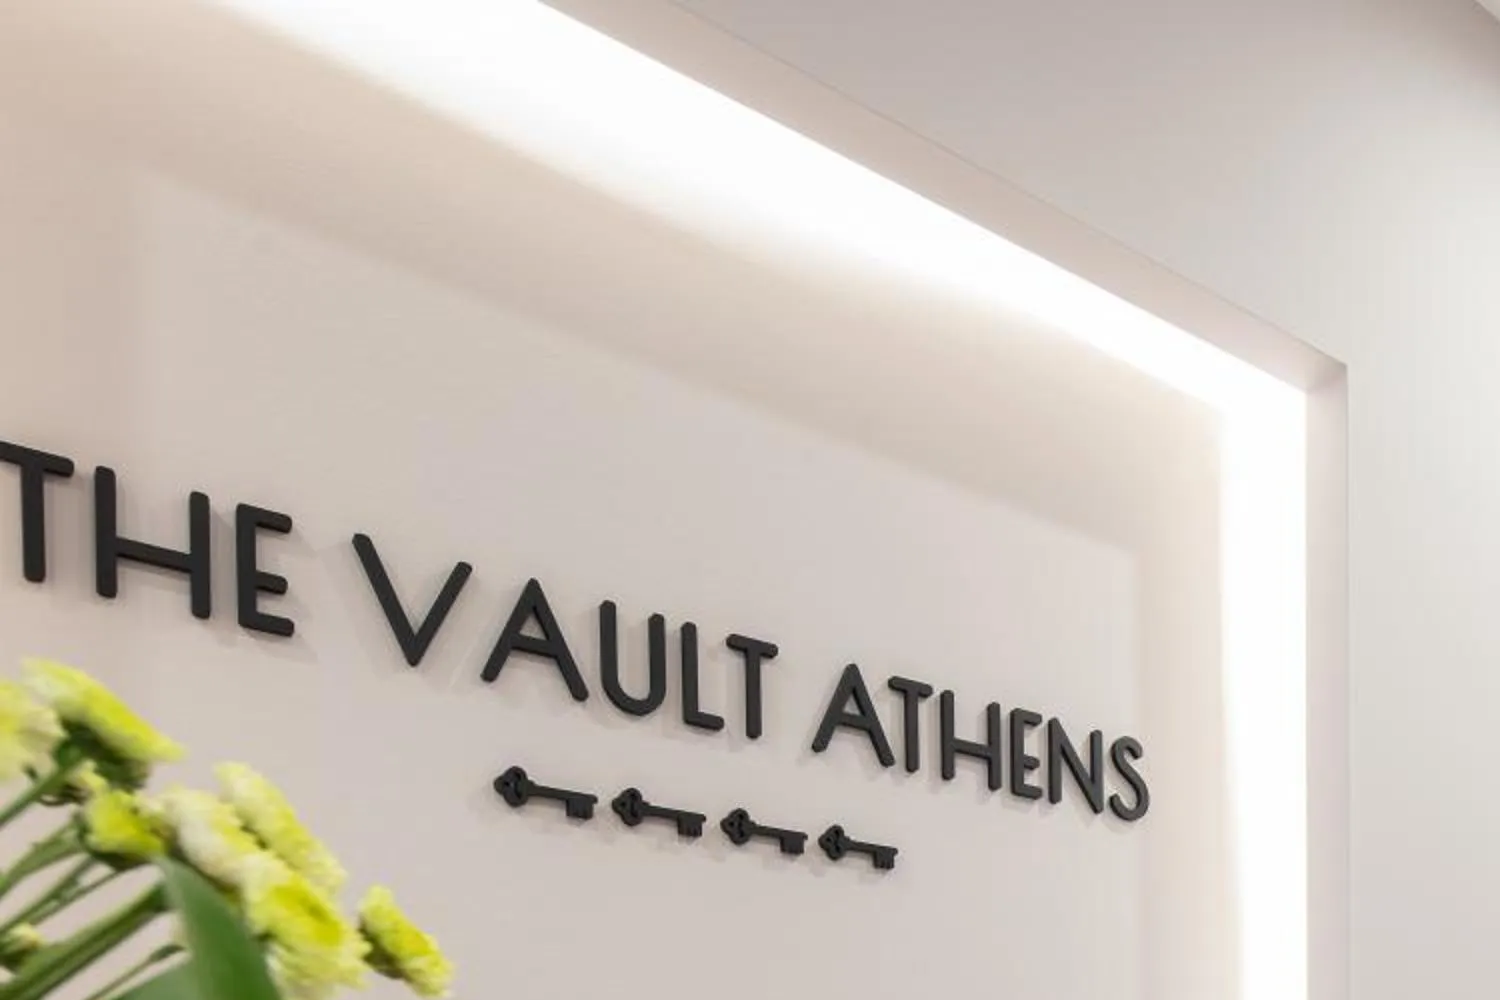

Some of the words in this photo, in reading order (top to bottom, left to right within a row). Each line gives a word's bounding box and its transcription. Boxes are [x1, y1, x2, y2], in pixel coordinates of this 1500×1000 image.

[0, 440, 295, 639] THE
[351, 533, 779, 741] VAULT
[811, 663, 1149, 822] ATHENS
